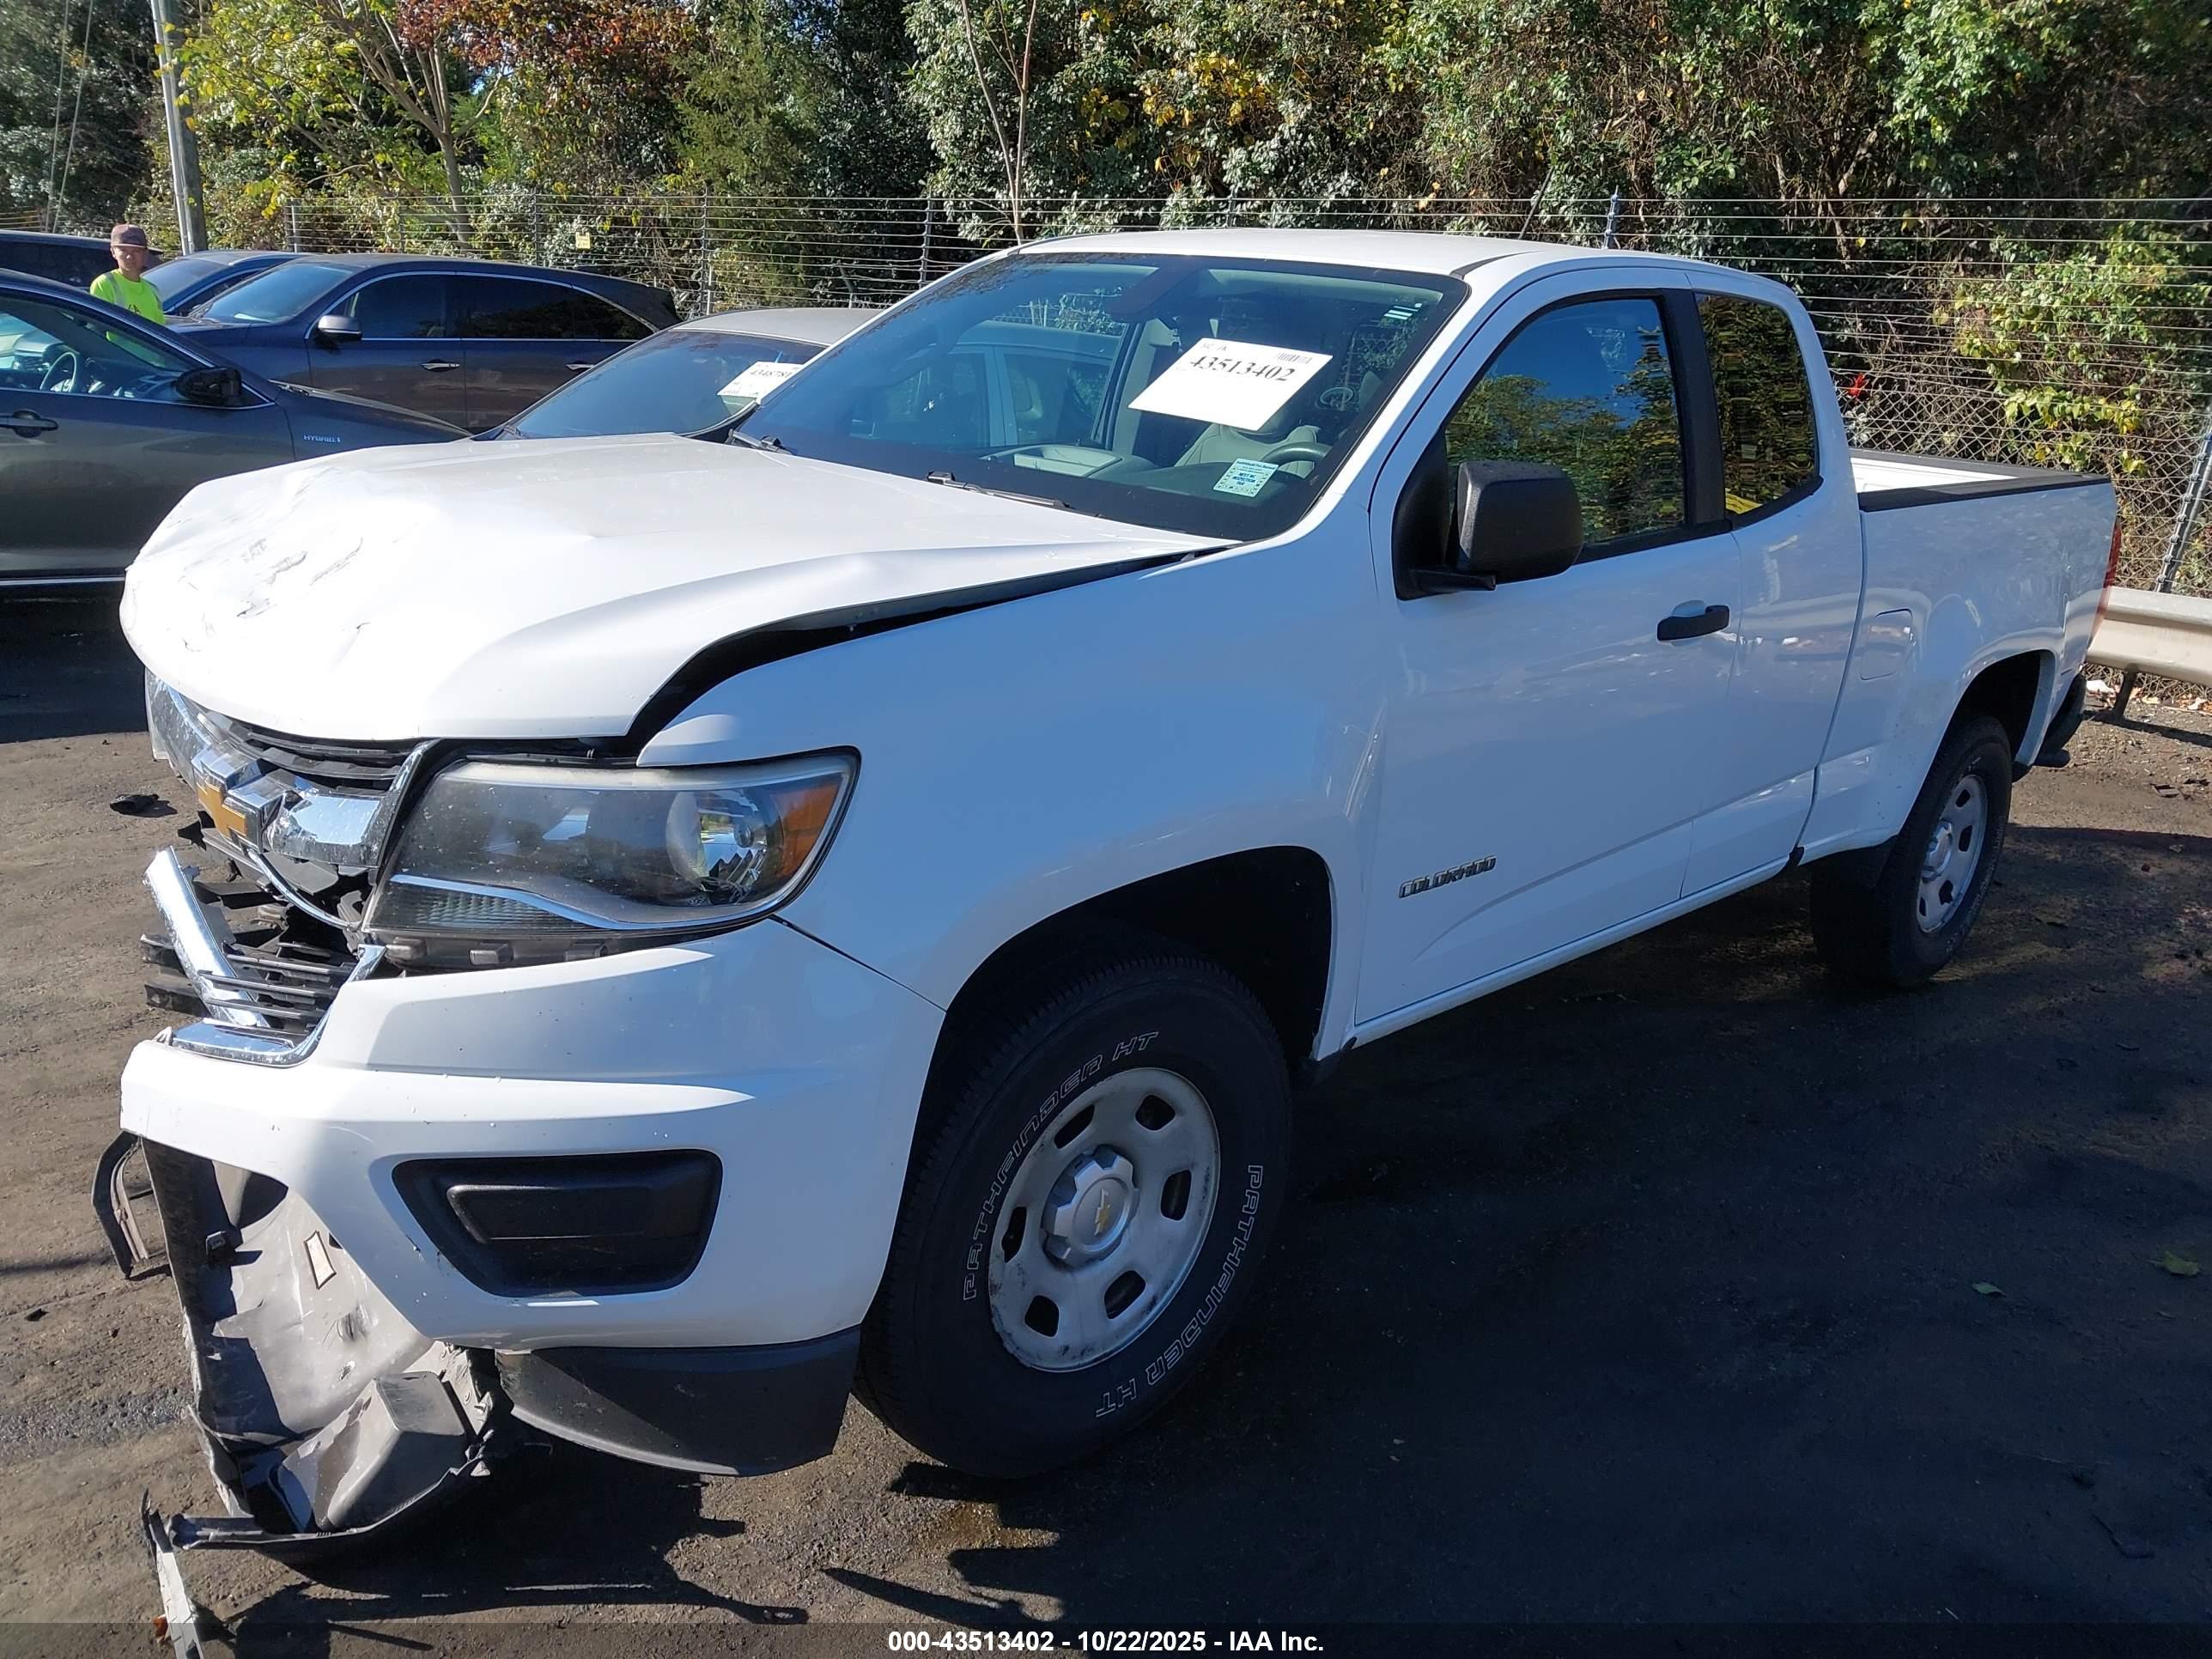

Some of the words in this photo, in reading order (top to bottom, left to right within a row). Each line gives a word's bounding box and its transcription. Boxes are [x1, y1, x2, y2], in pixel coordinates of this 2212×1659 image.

[1190, 356, 1296, 381] 43513402
[303, 434, 341, 443] HYBRID
[1399, 855, 1497, 898] COLORADO
[963, 1054, 1103, 1300] PATHFINDER
[1112, 1031, 1159, 1060] HT
[1146, 1164, 1264, 1386] PATHFINDER
[1095, 1378, 1138, 1418] HT
